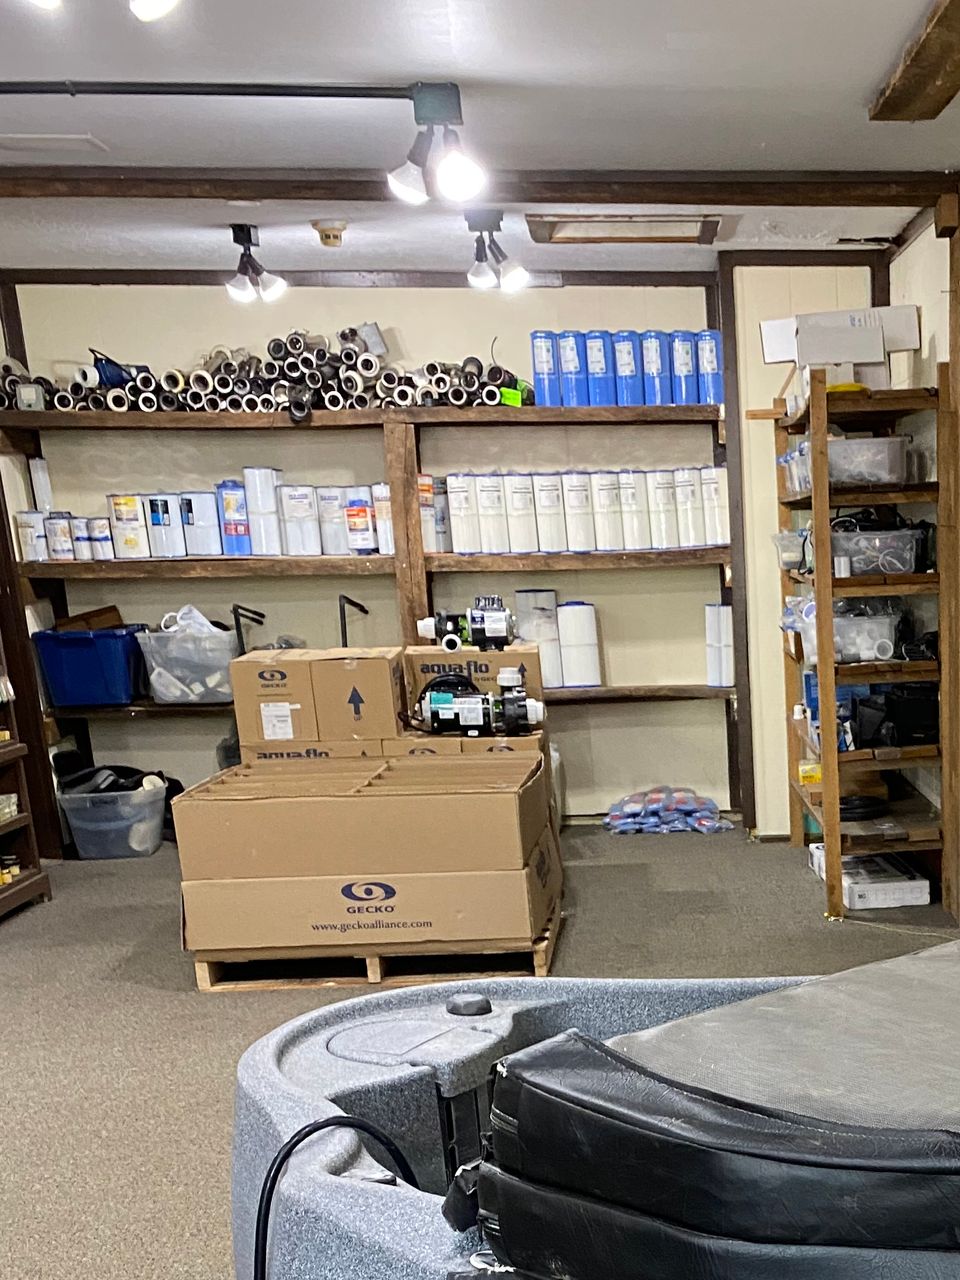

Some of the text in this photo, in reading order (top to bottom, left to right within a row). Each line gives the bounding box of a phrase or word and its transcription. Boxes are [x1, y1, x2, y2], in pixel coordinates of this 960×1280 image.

[420, 660, 489, 677] aqua-flo
[346, 905, 395, 914] GECKO
[311, 920, 433, 933] www.geckoalliance.com
